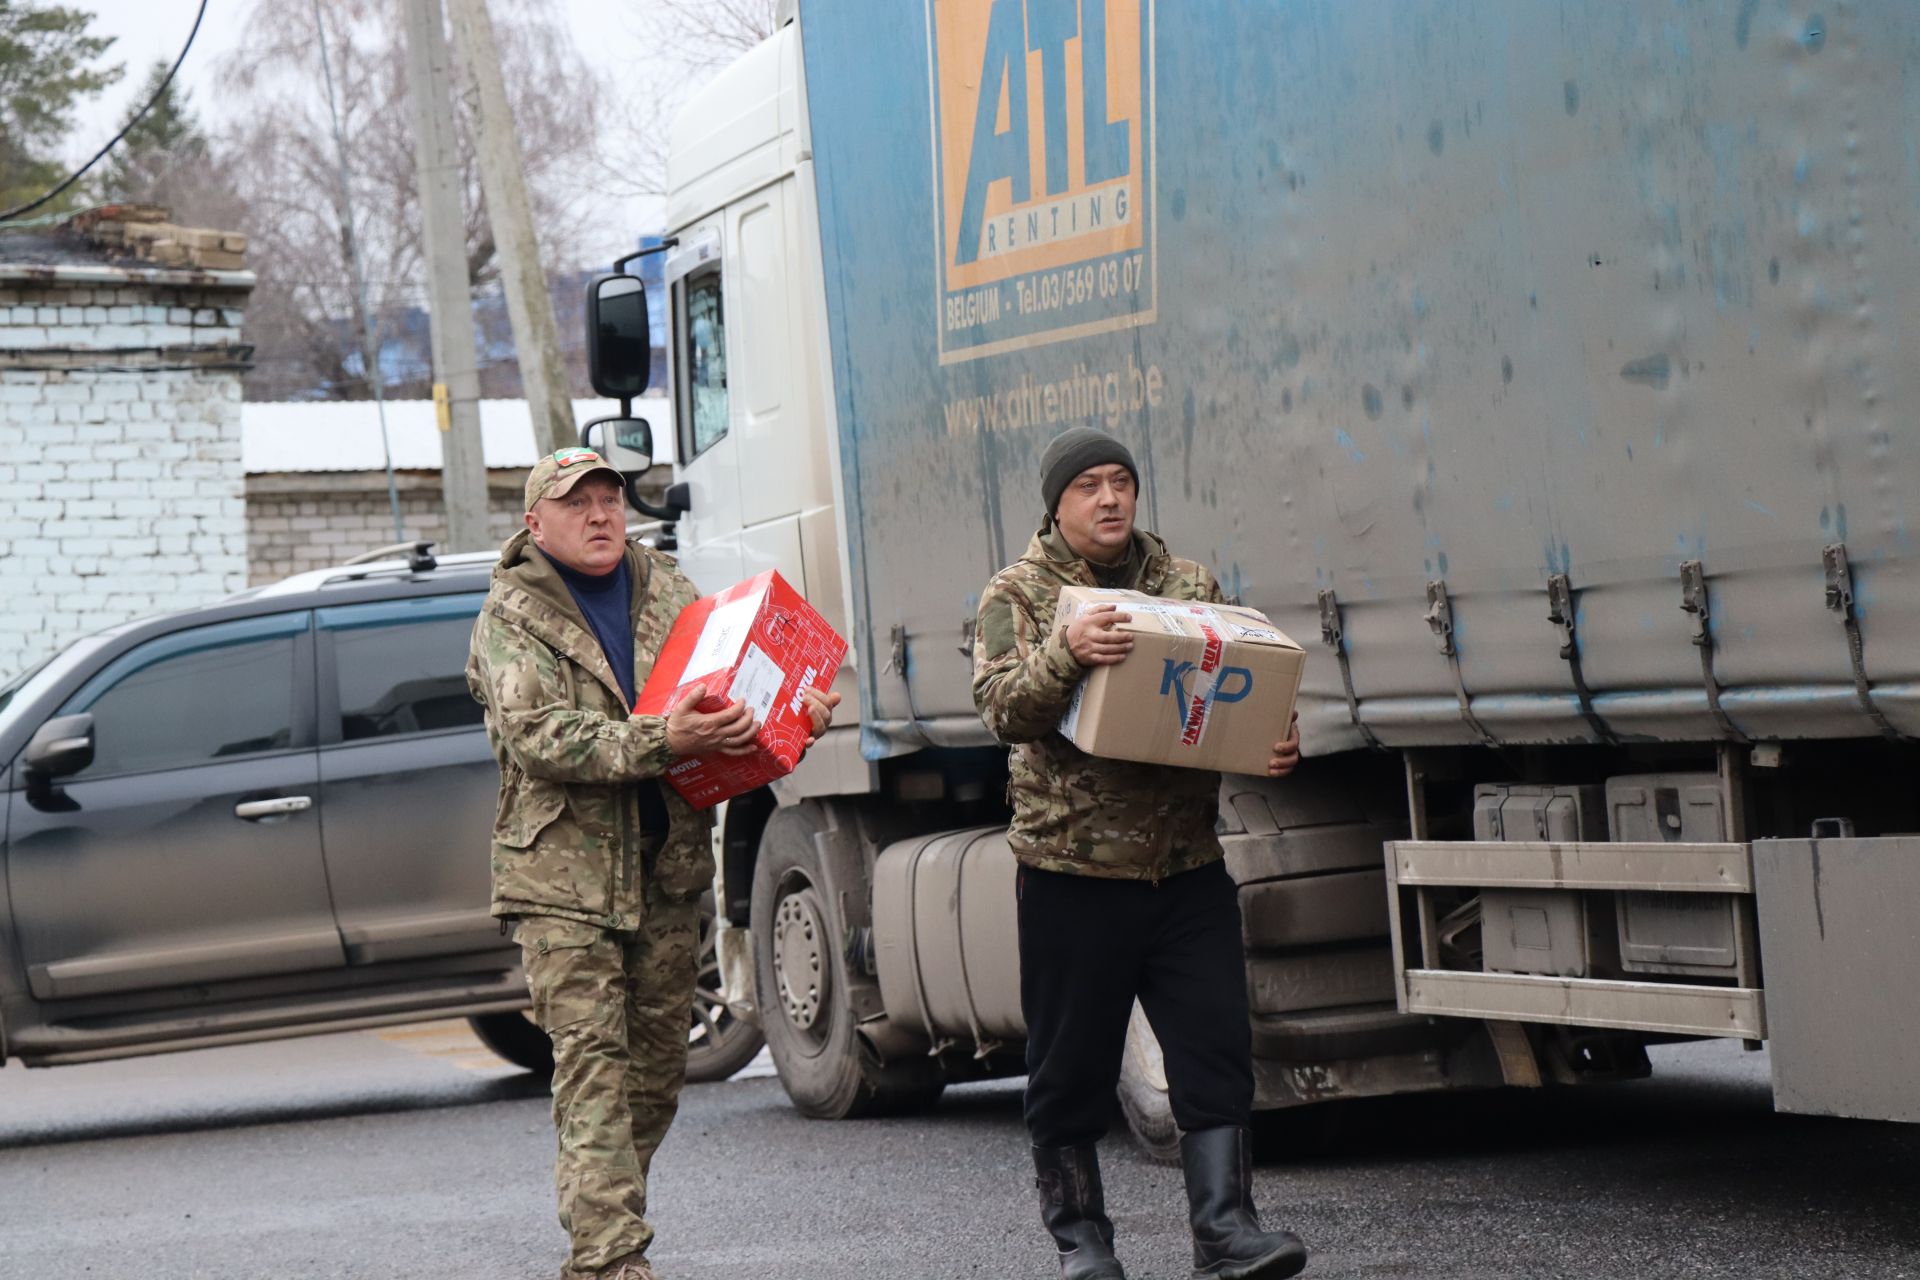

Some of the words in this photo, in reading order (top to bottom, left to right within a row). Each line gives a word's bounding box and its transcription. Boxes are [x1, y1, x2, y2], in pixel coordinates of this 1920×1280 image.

[955, 0, 1130, 267] ATL
[988, 188, 1127, 253] RENTING
[946, 287, 1000, 331] BELGIUM
[1099, 260, 1118, 298] 03
[1122, 253, 1143, 293] 07
[668, 759, 702, 777] MOTUL
